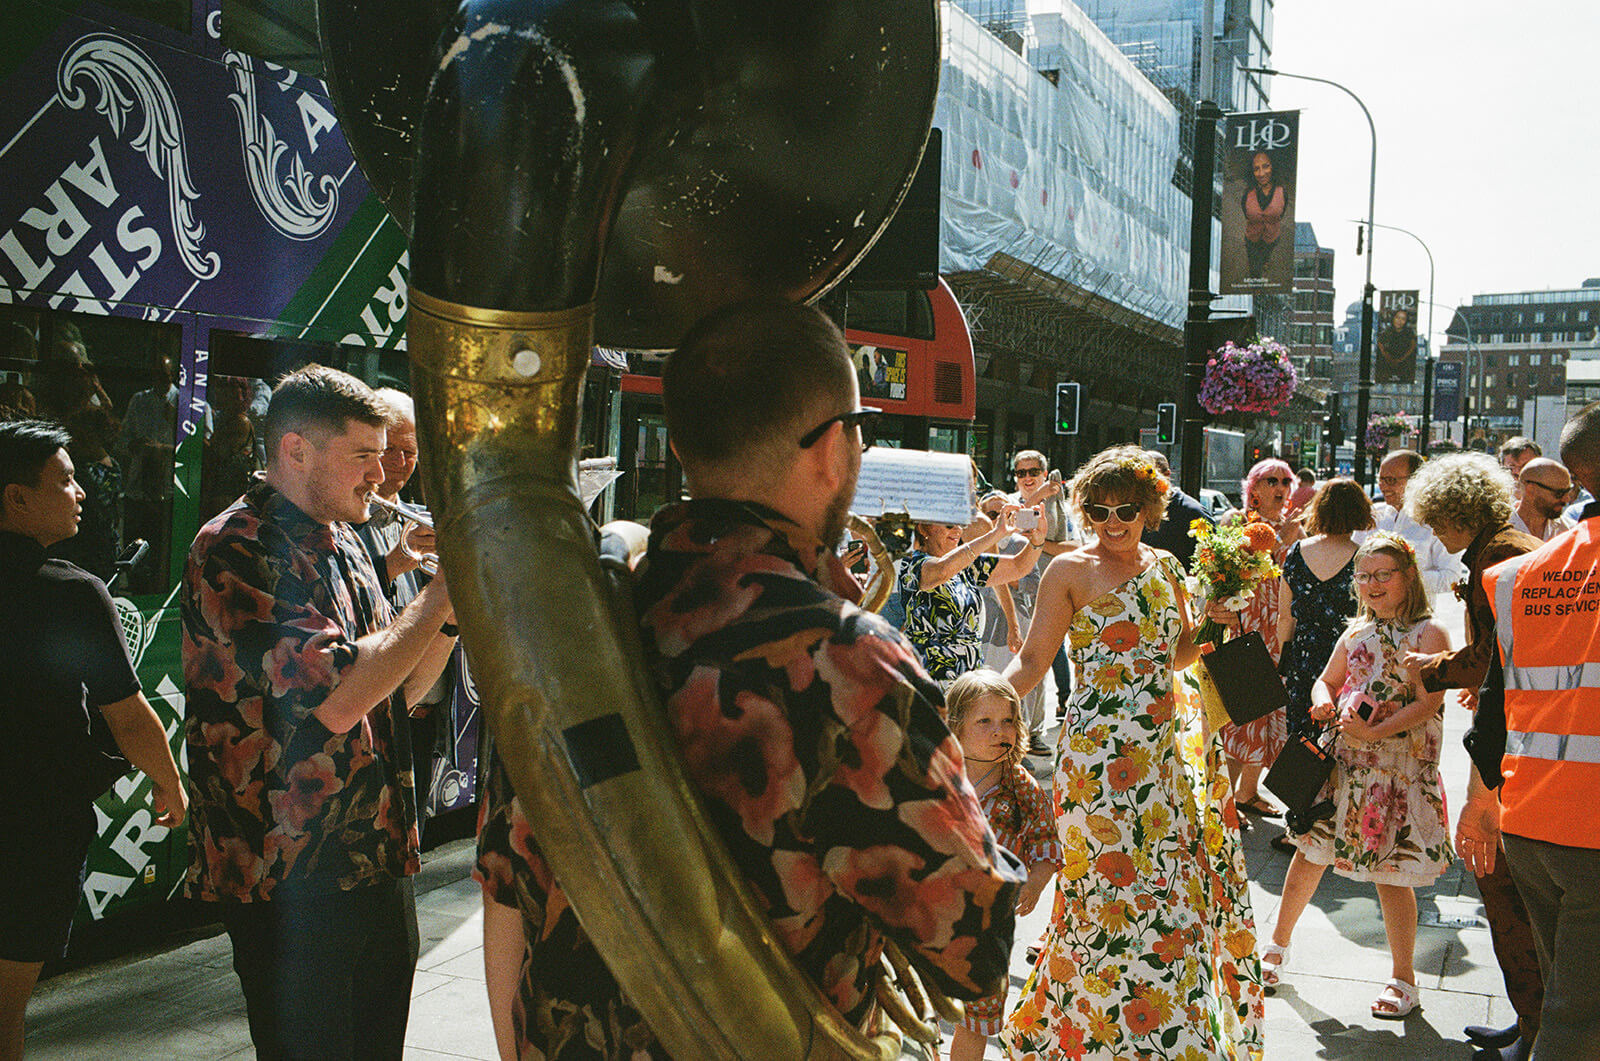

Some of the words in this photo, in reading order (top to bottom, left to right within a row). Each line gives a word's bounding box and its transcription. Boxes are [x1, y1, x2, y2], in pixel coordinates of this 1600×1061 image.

[0, 135, 120, 304] ART
[182, 349, 209, 436] ANNO
[1524, 604, 1551, 616] BUS
